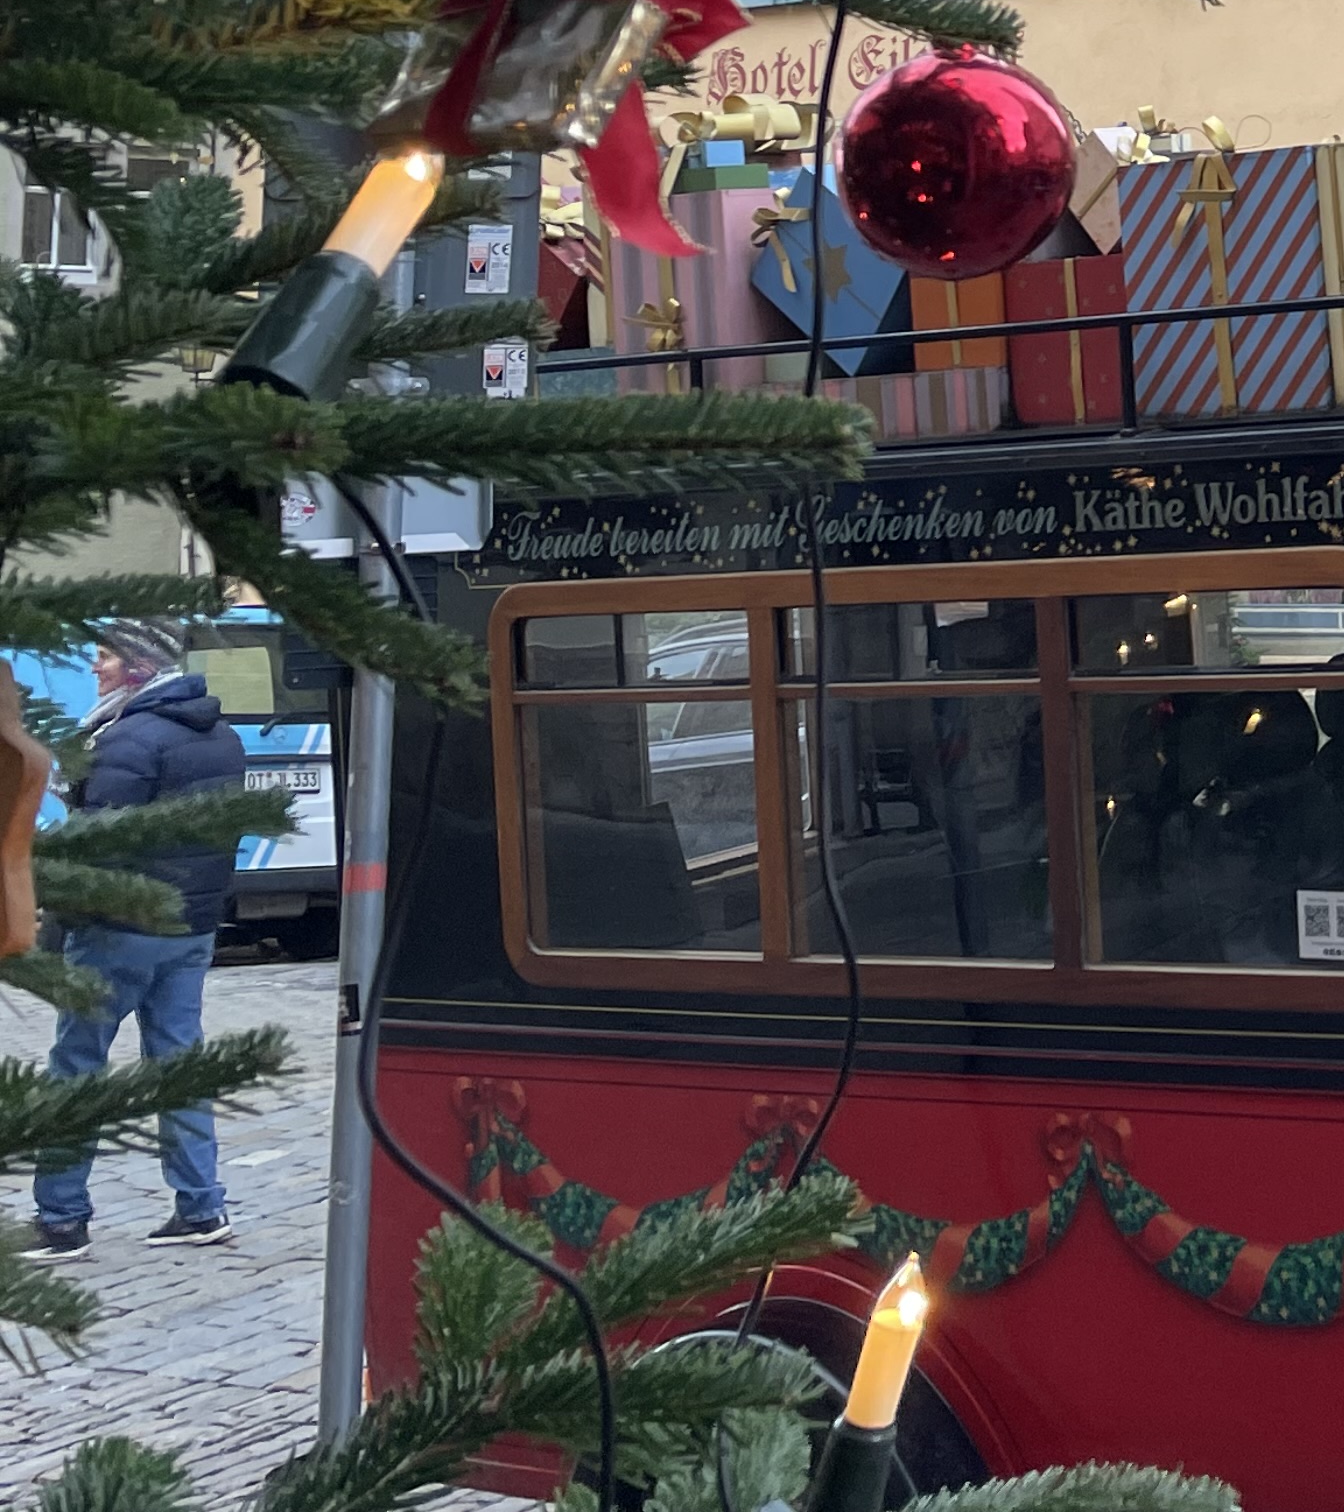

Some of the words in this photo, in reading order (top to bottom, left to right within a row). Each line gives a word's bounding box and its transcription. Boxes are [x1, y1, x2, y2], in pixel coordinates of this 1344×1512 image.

[707, 39, 826, 105] Hotel
[507, 511, 604, 561] Freude
[610, 511, 720, 556] bereiten
[729, 506, 789, 551] mit
[994, 505, 1058, 535] von
[1073, 487, 1186, 533] Käthe
[294, 772, 317, 787] 333
